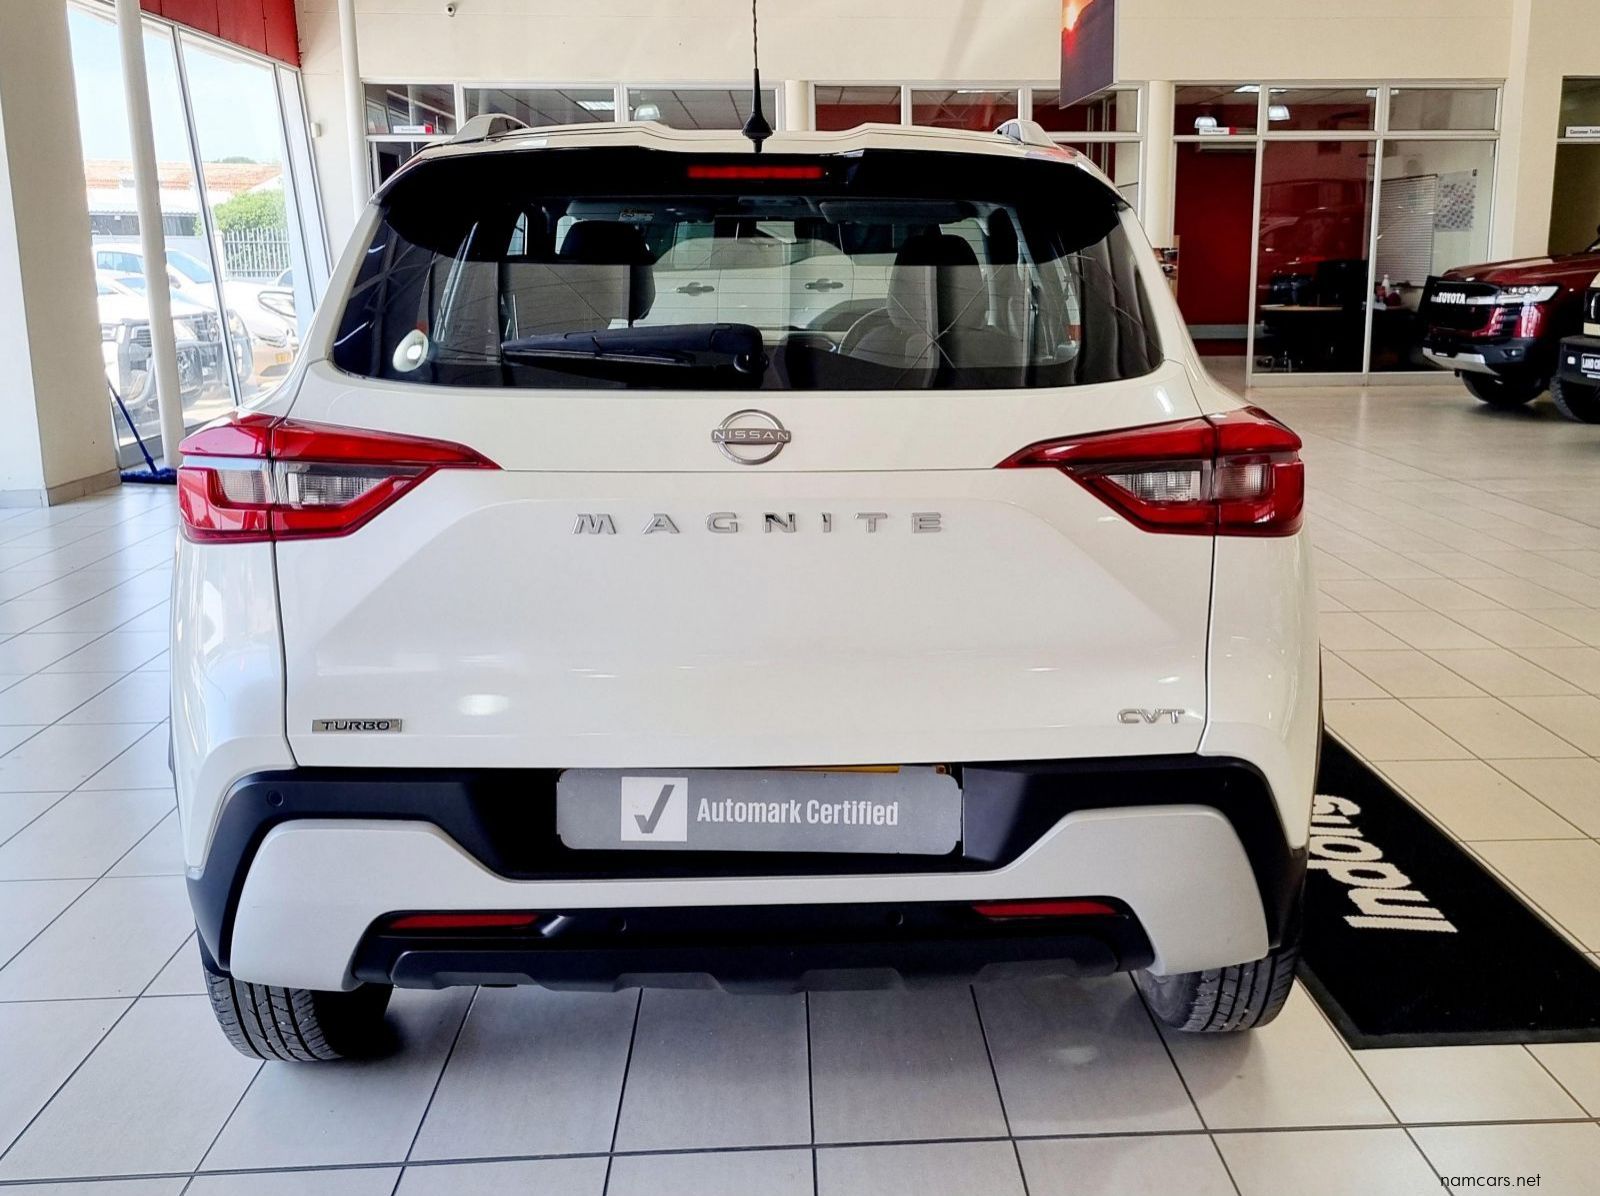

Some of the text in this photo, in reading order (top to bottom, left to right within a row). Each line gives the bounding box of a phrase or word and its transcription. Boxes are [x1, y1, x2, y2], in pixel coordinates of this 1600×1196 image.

[1438, 292, 1466, 304] TOYOTA
[713, 430, 789, 440] NISSAN
[572, 512, 943, 535] MAGNITE
[1117, 708, 1185, 724] CVT
[321, 720, 391, 731] TURBO
[697, 797, 899, 826] Automark Certified
